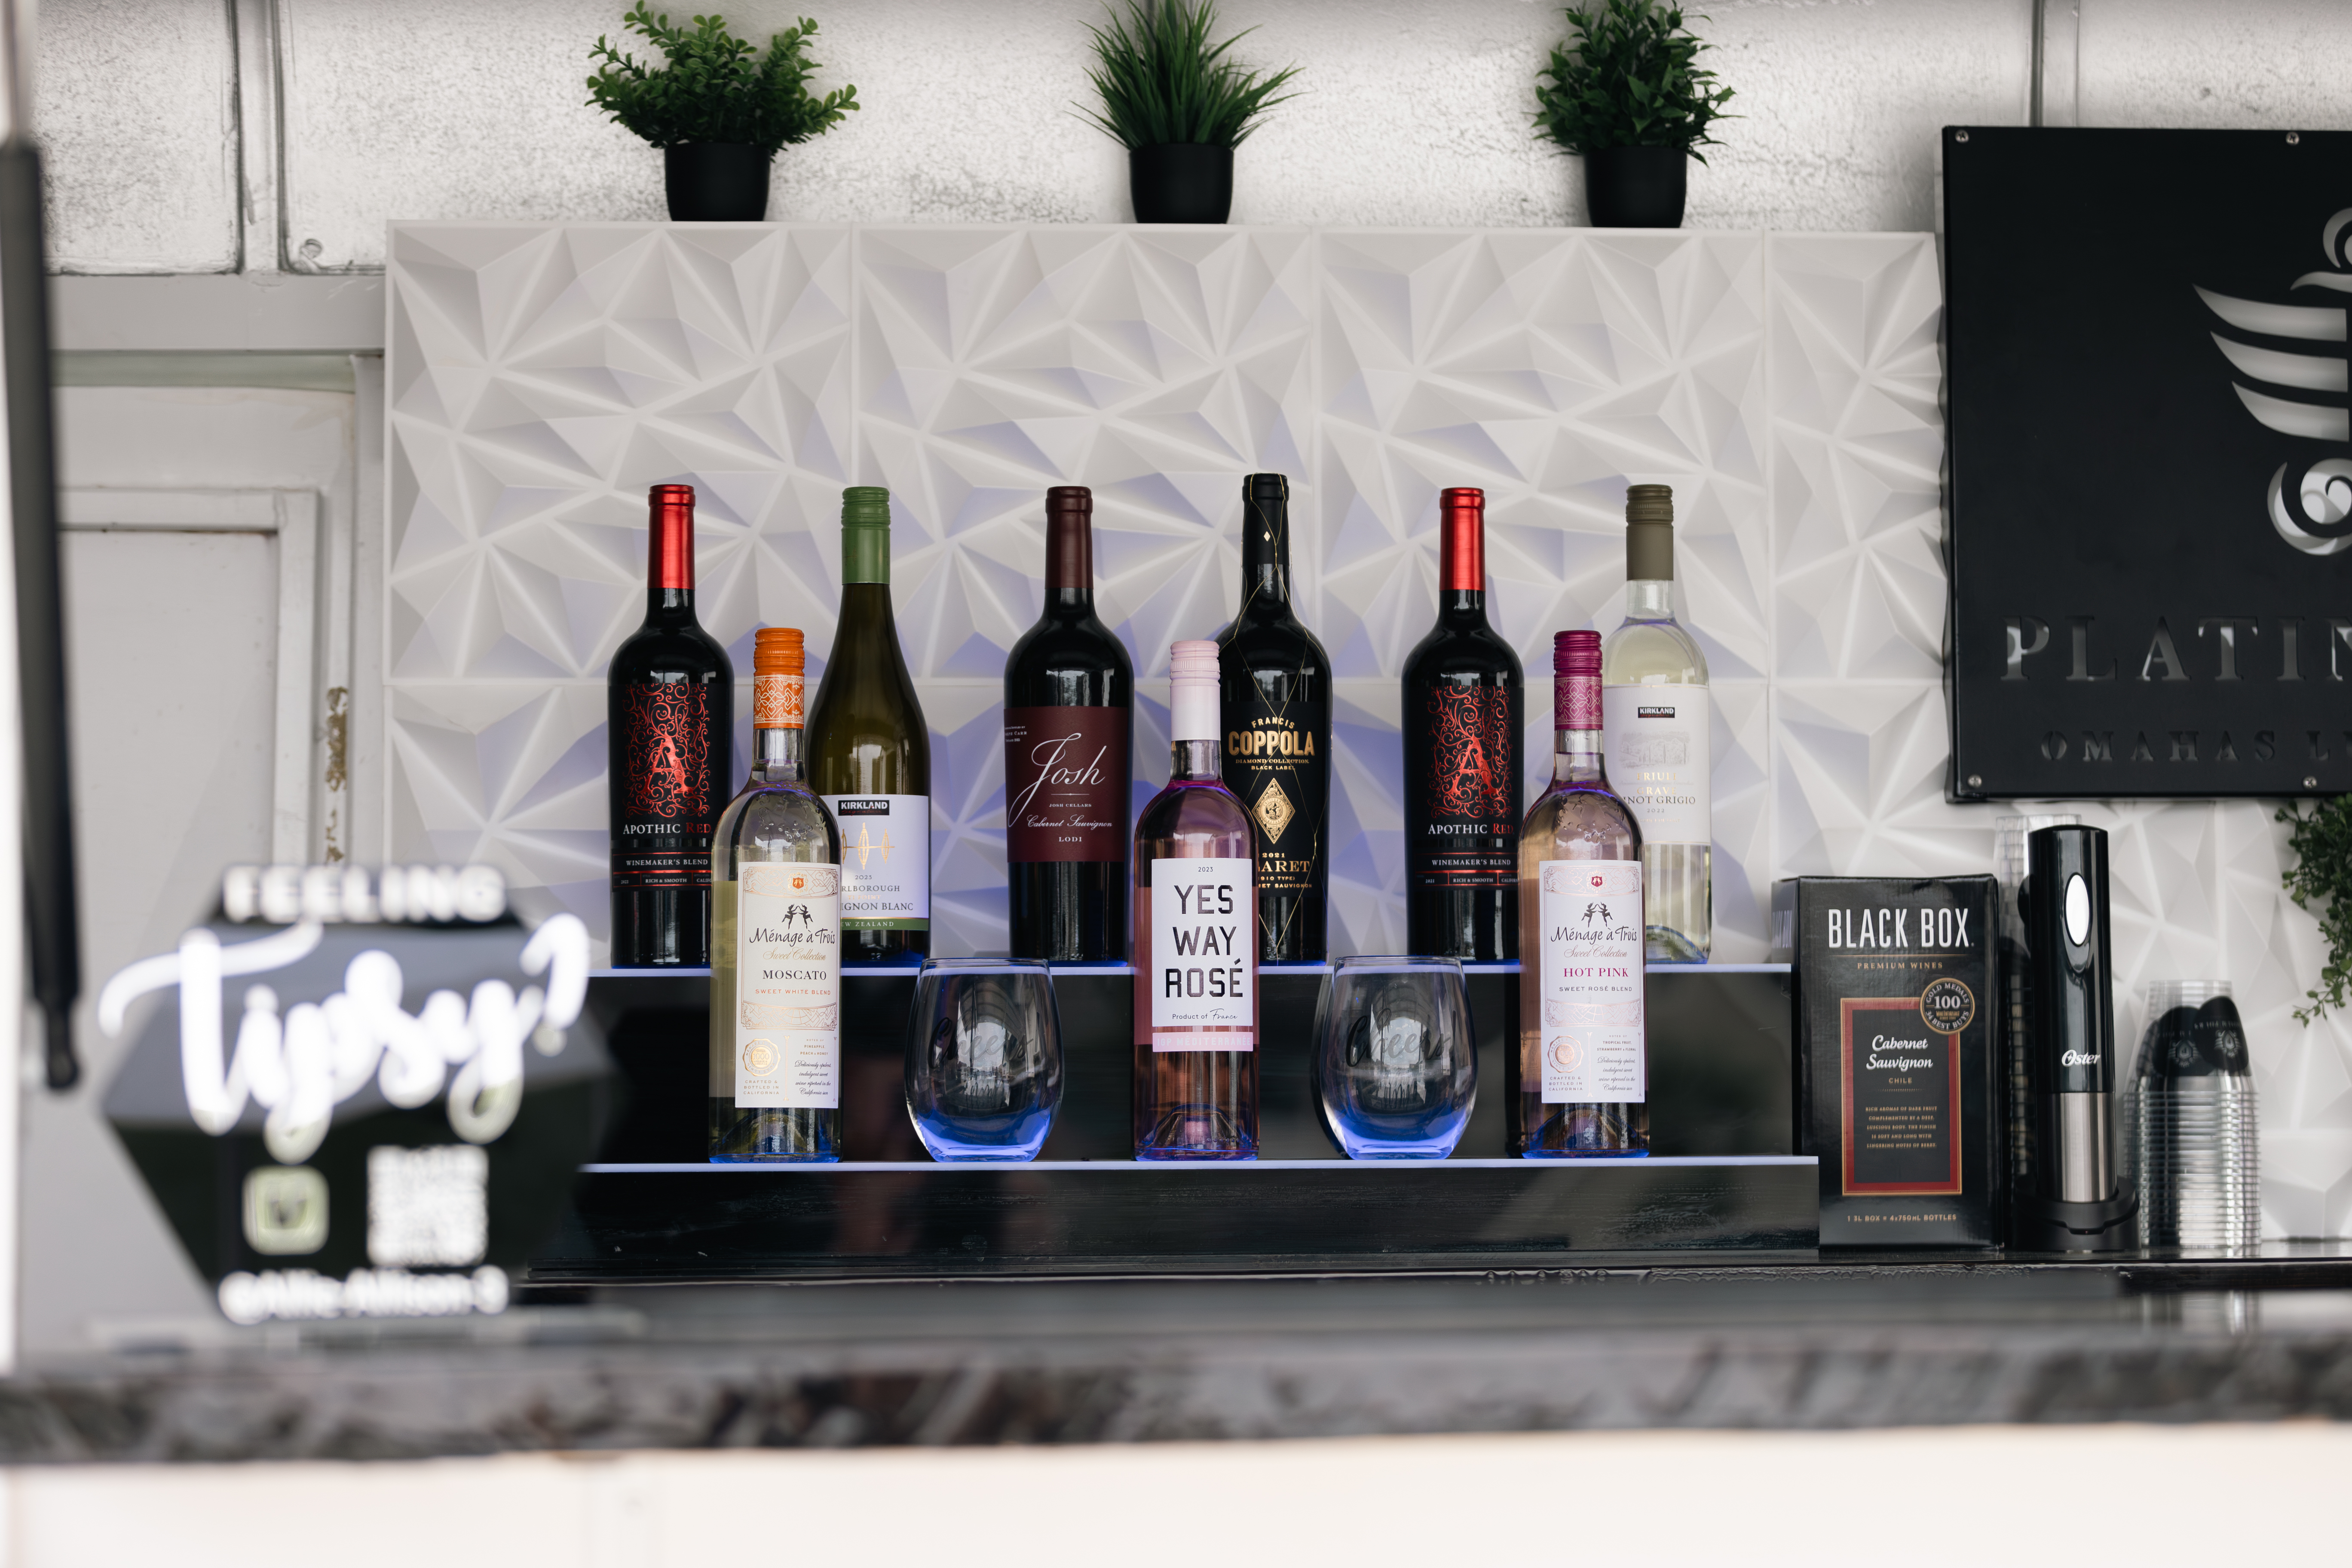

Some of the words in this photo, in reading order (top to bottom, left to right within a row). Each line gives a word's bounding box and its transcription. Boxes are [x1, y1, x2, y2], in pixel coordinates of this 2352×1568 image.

[1252, 717, 1295, 729] FRANCIS
[1228, 731, 1315, 756] COPPOLA
[2041, 730, 2275, 762] OMAHAS
[2307, 730, 2352, 761] L
[1008, 733, 1106, 827] Josh
[623, 824, 680, 834] APOTHIC
[1027, 815, 1064, 827] Cabernet
[1067, 815, 1112, 830] Sauvignon
[1428, 824, 1487, 834] APOTHIC
[1259, 861, 1310, 872] ARET
[1174, 885, 1233, 914] YES
[1551, 926, 1603, 945] Ménage
[1606, 928, 1614, 940] à
[1615, 926, 1637, 941] Trois
[1828, 908, 1908, 948] BLACK
[1921, 908, 1969, 948] BOX
[750, 928, 803, 947] Ménage
[806, 930, 814, 943] à
[815, 928, 835, 944] Trois
[1173, 926, 1237, 956] WAY
[763, 947, 792, 959] Sweet
[792, 947, 826, 961] Collection
[1564, 945, 1592, 958] Sweet
[1592, 944, 1628, 957] Collection
[763, 970, 827, 980] MOSCATO
[1166, 958, 1243, 998] ROSÉ
[1563, 968, 1593, 977] HOT
[1599, 968, 1629, 977] PINK
[1926, 984, 1942, 1004] GOLD
[1945, 983, 1969, 1004] MEDALS
[1934, 995, 1960, 1009] 100
[1210, 1008, 1238, 1021] France
[1932, 1018, 1950, 1029] BEST
[1952, 1011, 1969, 1029] BUYS
[1158, 1038, 1172, 1046] IGP
[1872, 1035, 1928, 1051] Cabernet
[1866, 1054, 1933, 1072] Sauvignon
[2061, 1050, 2101, 1067] Oster
[1603, 1084, 1626, 1093] California
